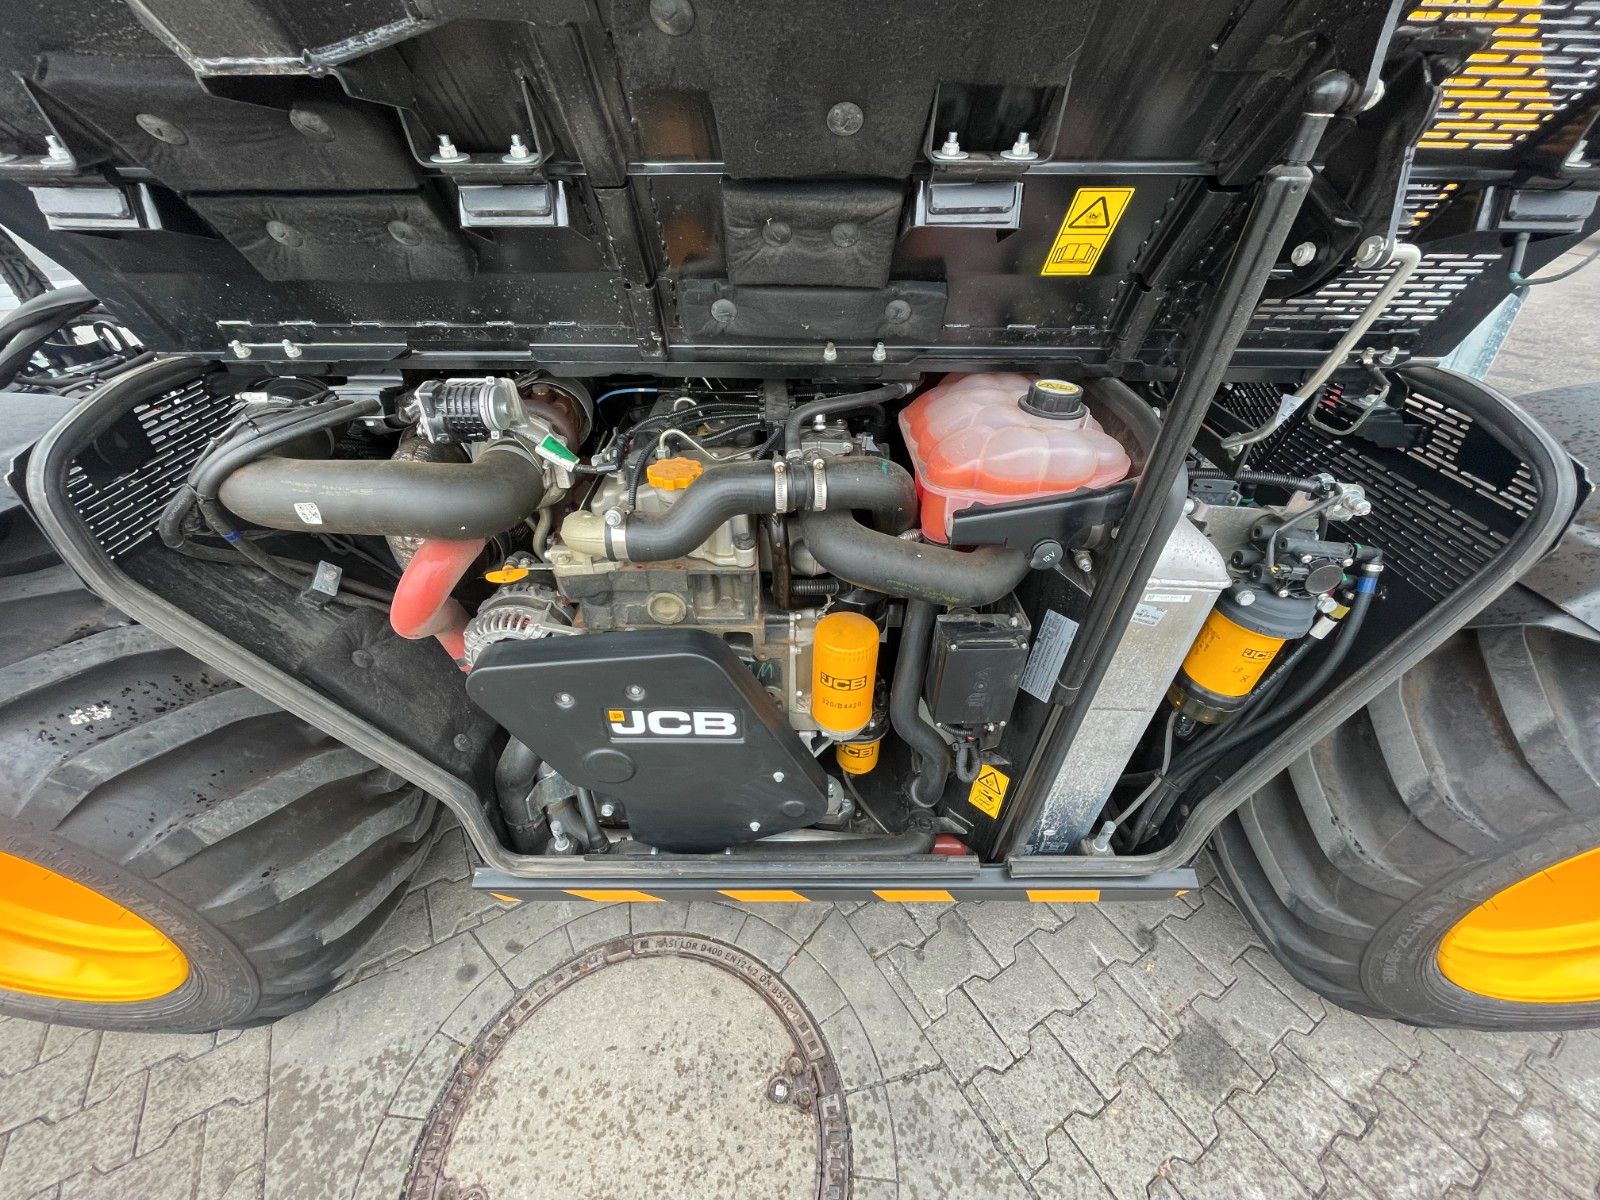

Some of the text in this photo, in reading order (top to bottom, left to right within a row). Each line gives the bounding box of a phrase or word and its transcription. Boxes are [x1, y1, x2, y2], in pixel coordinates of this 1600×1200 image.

[1043, 551, 1055, 563] 12V
[820, 672, 866, 691] JCB
[608, 710, 737, 736] JCB
